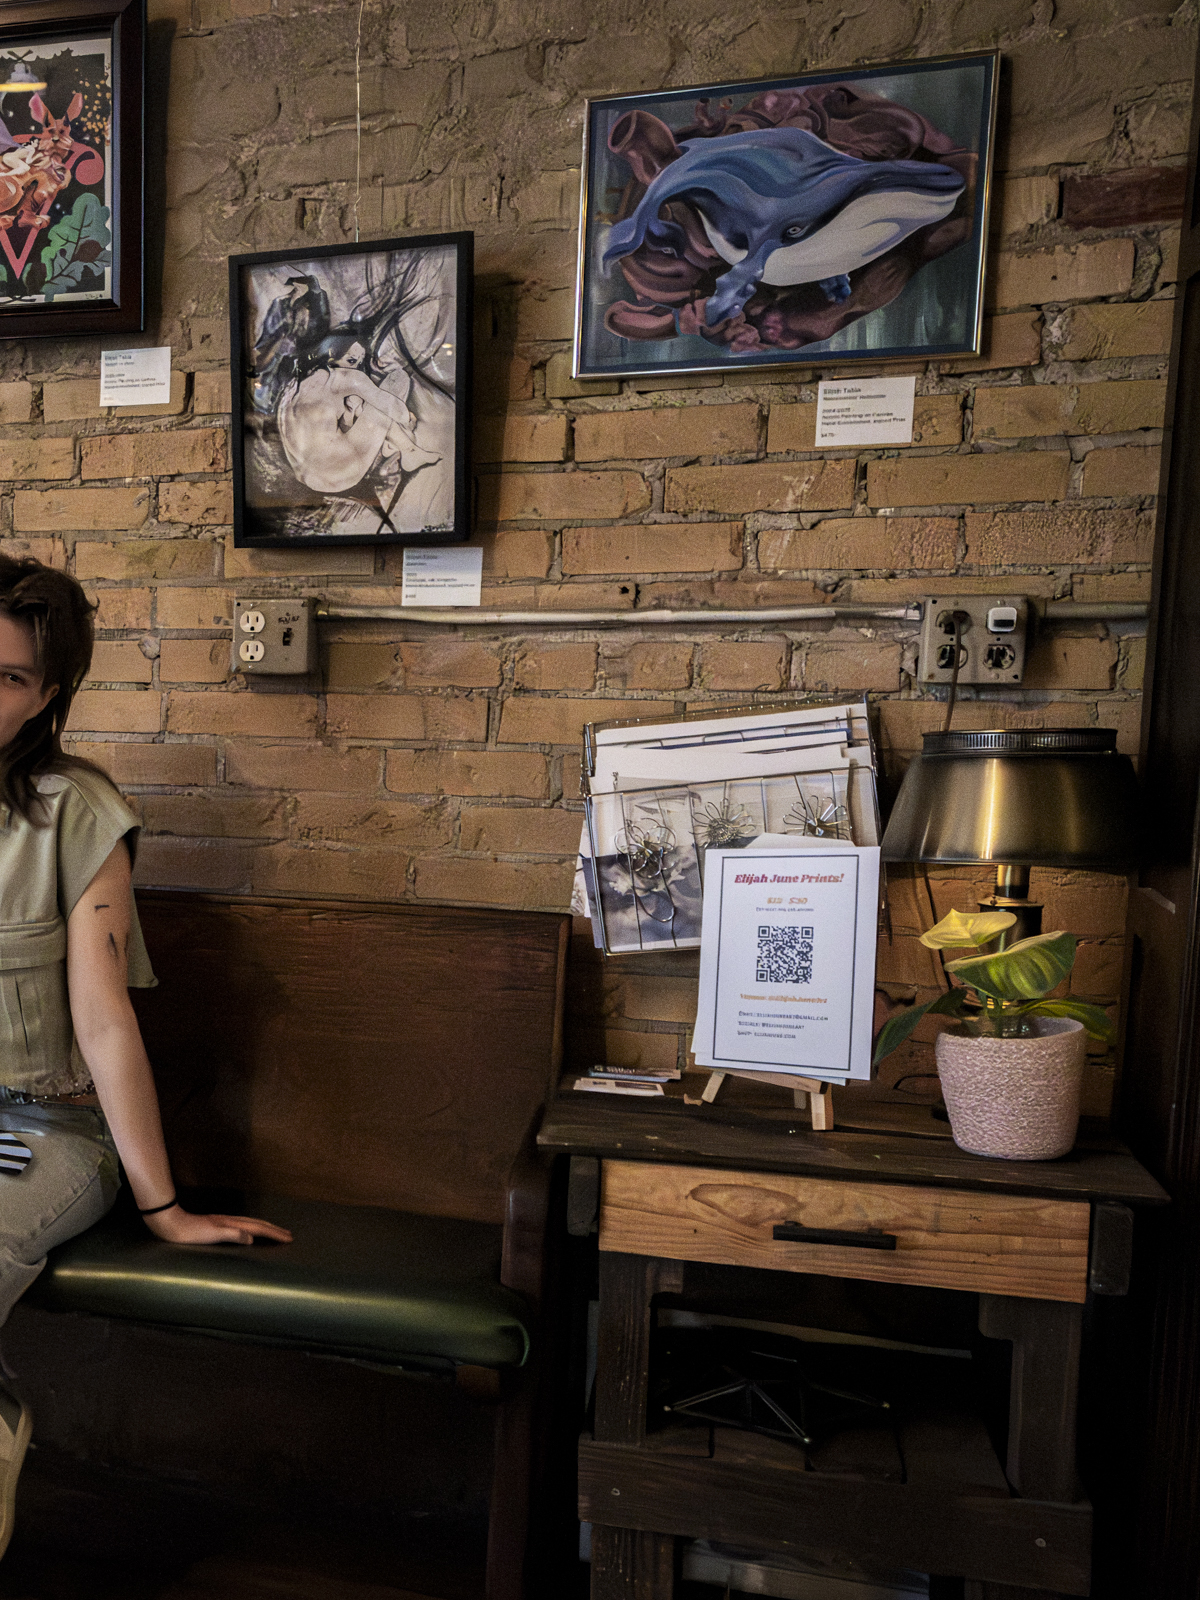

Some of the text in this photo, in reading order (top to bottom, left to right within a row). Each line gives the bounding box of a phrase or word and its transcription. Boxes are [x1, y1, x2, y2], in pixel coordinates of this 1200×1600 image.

[734, 873, 845, 885] Elijah June Prints!
